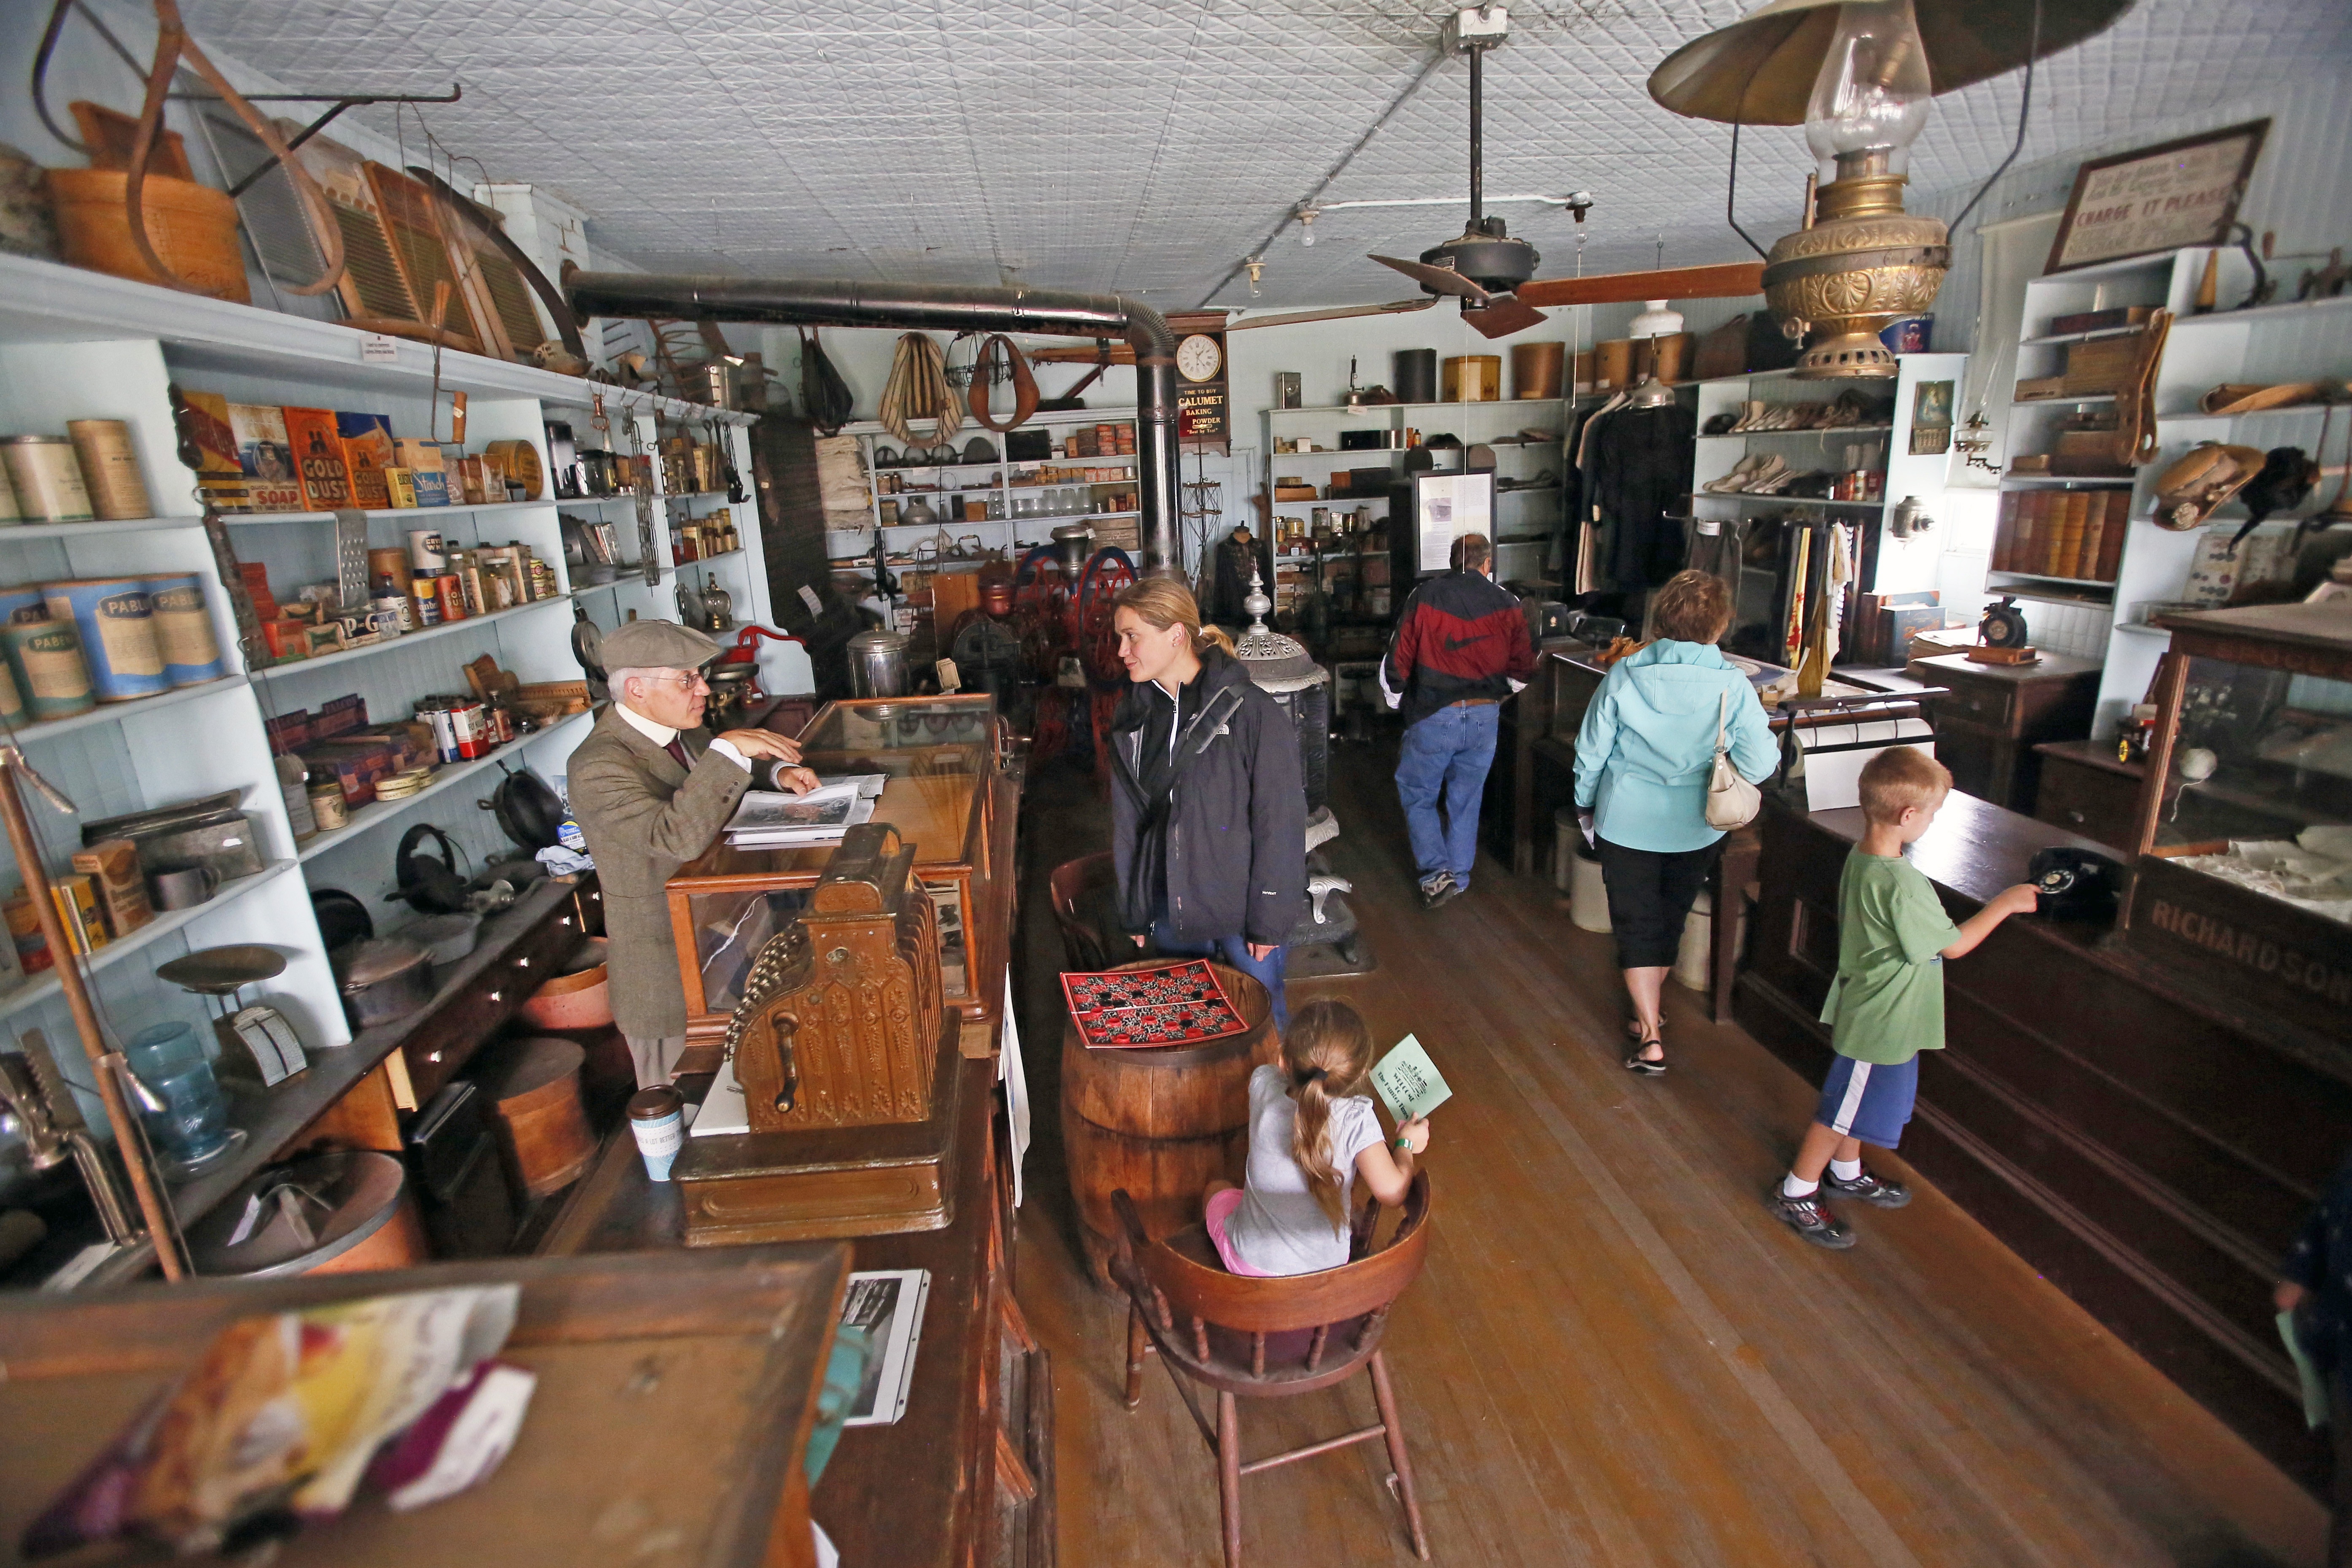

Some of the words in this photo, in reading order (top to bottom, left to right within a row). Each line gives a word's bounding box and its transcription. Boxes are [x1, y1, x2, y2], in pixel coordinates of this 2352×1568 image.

[1178, 396, 1223, 407] CALUMET
[303, 459, 344, 478] GOLD
[307, 479, 349, 499] DUST
[412, 472, 445, 493] Starch
[257, 490, 298, 505] SOAP
[357, 486, 385, 499] DUST
[1377, 1071, 1386, 1083] The
[1398, 1103, 1409, 1119] Times
[1393, 1073, 1415, 1102] WELCOME
[1394, 1085, 1401, 1094] To
